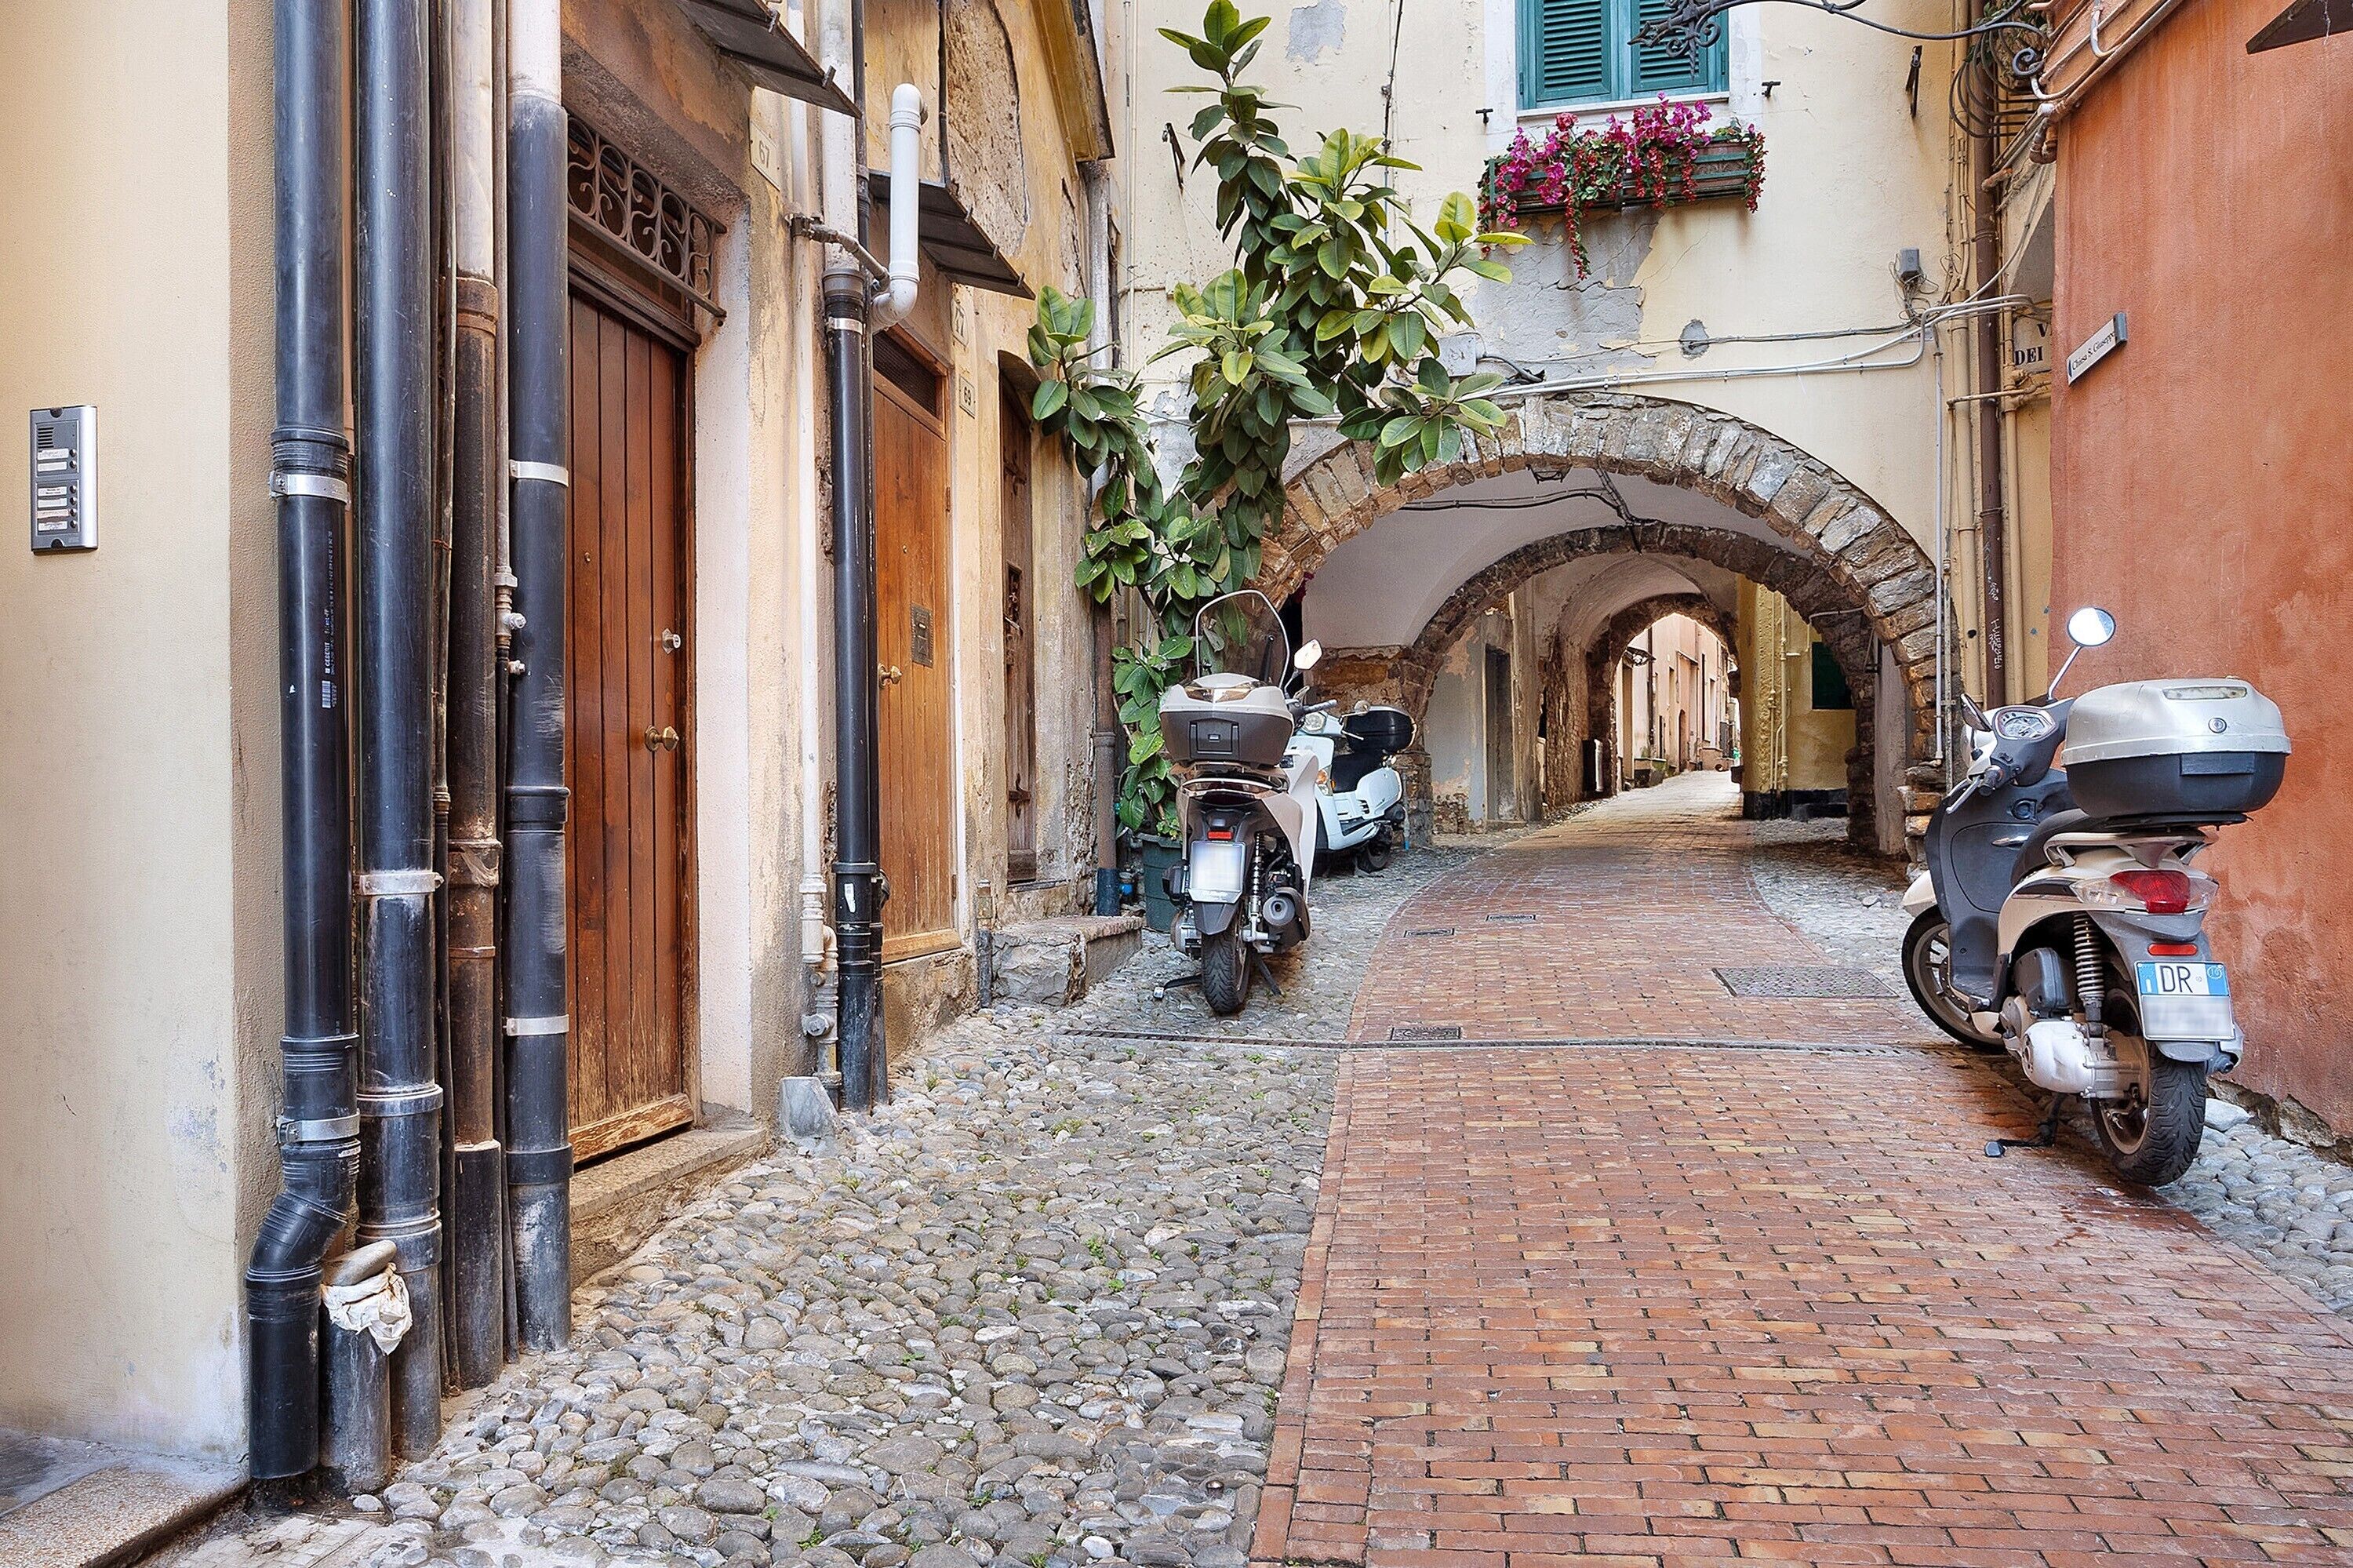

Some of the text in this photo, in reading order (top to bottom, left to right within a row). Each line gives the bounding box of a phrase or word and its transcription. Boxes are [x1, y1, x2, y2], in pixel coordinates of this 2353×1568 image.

[758, 140, 770, 169] 67
[2015, 346, 2043, 366] DEI
[2072, 355, 2088, 370] Chiesa
[964, 387, 972, 406] 69
[2159, 965, 2193, 993] DR
